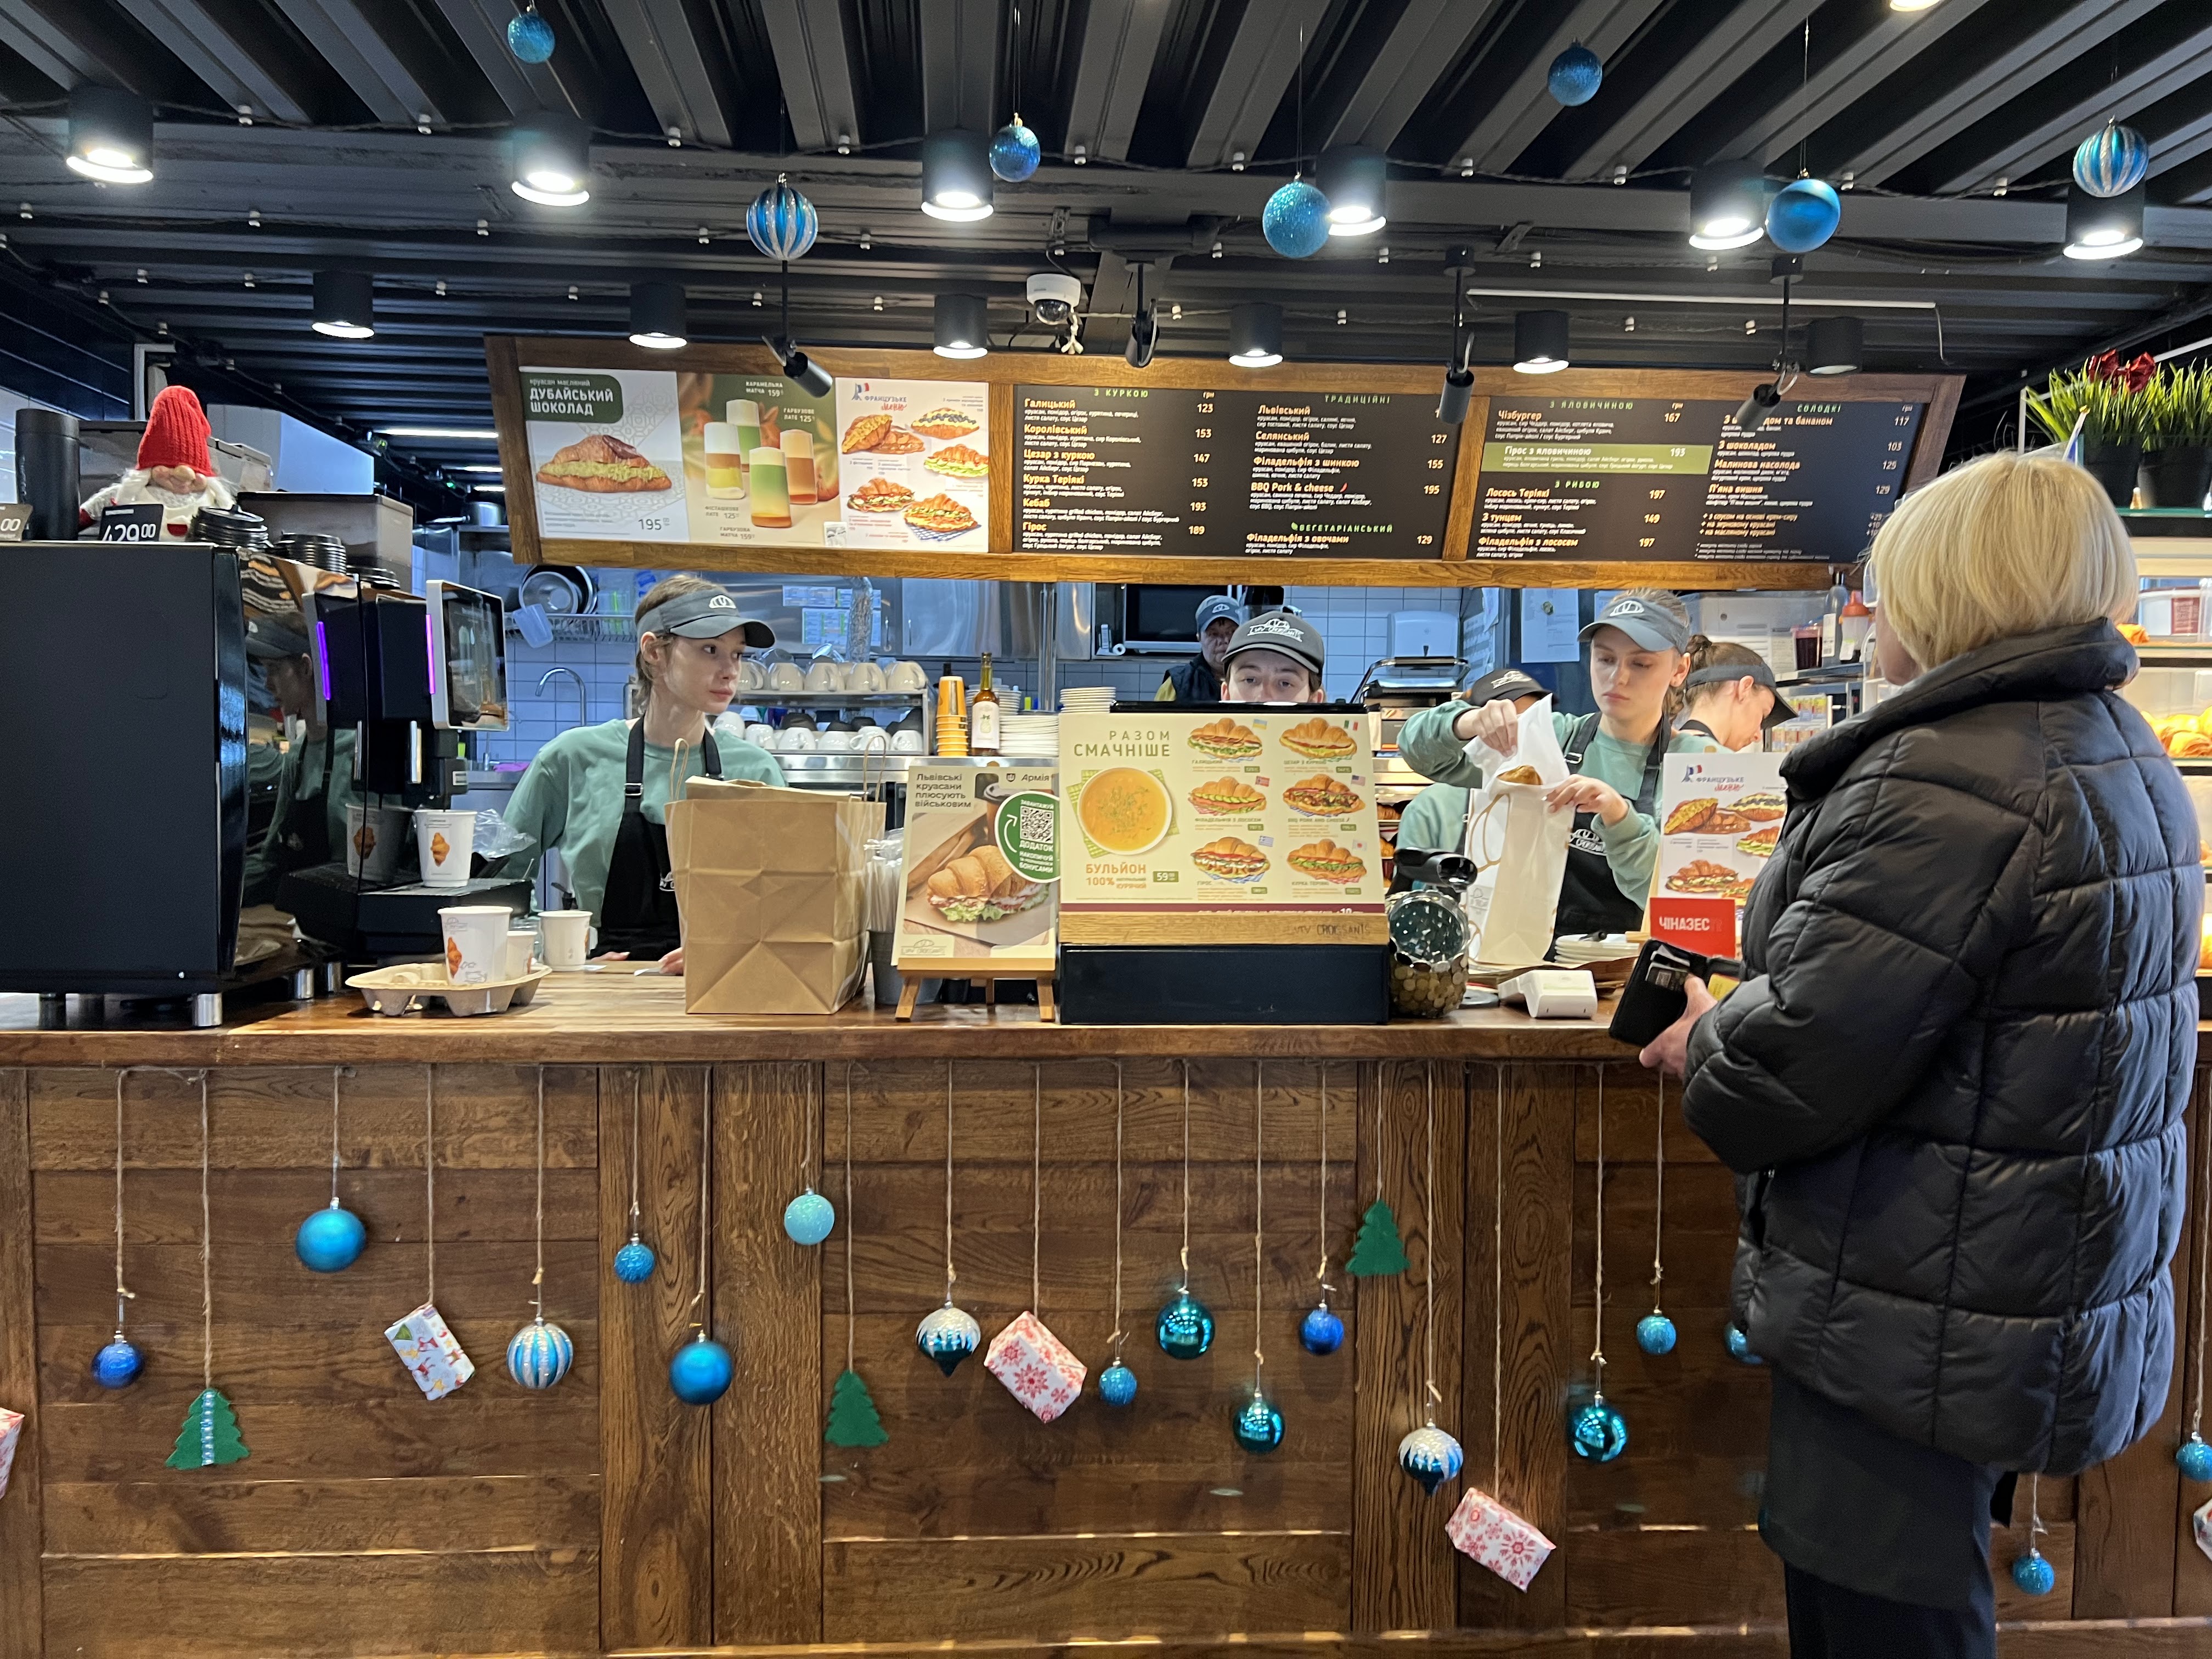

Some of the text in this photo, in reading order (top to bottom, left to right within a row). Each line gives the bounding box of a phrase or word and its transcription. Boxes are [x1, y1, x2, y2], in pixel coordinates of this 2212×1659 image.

[530, 387, 613, 402] ДУБАЙСЬКИЙ
[1105, 389, 1148, 398] КУРКОЮ
[1024, 398, 1076, 409] Галицький
[1325, 395, 1390, 404] ТРАДИЦІЙНІ
[531, 402, 594, 416] ШОКОЛАД
[1198, 403, 1214, 413] 123
[1258, 405, 1311, 415] Львівський
[1561, 401, 1633, 410] ЯЛОВИЧИНОЮ
[1797, 404, 1841, 413] СОЛОДКІ
[1498, 410, 1542, 421] Чізбургер
[1664, 413, 1681, 422] 167
[1784, 417, 1793, 425] та
[1796, 415, 1833, 426] бананом
[1894, 416, 1910, 426] 117
[1024, 424, 1087, 435] Королівський
[1195, 428, 1212, 438] 153
[1255, 431, 1310, 441] Селянський
[1431, 434, 1448, 444] 127
[1536, 447, 1592, 455] яловичиною
[1726, 442, 1776, 451] шоколадом
[1024, 449, 1052, 460] Цезар
[1061, 452, 1095, 460] куркою
[1670, 448, 1686, 457] 193
[1194, 453, 1210, 463] 147
[1253, 456, 1313, 467] Філадельфія
[1323, 459, 1360, 467] шинкою
[1427, 459, 1443, 469] 155
[1714, 459, 1800, 470] Малинова насолода
[1023, 473, 1085, 485] Курка Теріякі
[1192, 478, 1208, 487] 153
[1251, 482, 1334, 493] BBQ Pork & cheese
[1565, 480, 1600, 489] РИБОЮ
[1424, 485, 1440, 495] 195
[1486, 488, 1550, 499] Лосось Теріякі
[1649, 489, 1666, 499] 197
[1735, 486, 1764, 494] вишня
[1023, 498, 1051, 507] Кебаб
[1190, 502, 1206, 511] 193
[1491, 514, 1522, 523] тунцем
[1644, 514, 1661, 524] 149
[638, 518, 662, 530] 195
[1023, 522, 1047, 532] Гірос
[1299, 523, 1393, 533] ВЕГЕТАРІАНСЬКИЙ
[1189, 526, 1205, 535] 189
[1246, 533, 1302, 543] Філадельфія
[1417, 535, 1433, 545] 129
[1478, 537, 1534, 547] Філадельфія
[1639, 538, 1655, 547] 197
[1109, 730, 1170, 741] РАЗОМ
[1074, 744, 1170, 757] СМАЧНІШЕ
[1021, 774, 1049, 782] Армія
[1019, 840, 1053, 851] ДОДАТОК
[1086, 861, 1146, 874] БУЛЬЙОН
[1086, 877, 1115, 885] 100%
[1156, 872, 1168, 881] 59
[1658, 916, 1710, 932] ЧІНАЗЕС
